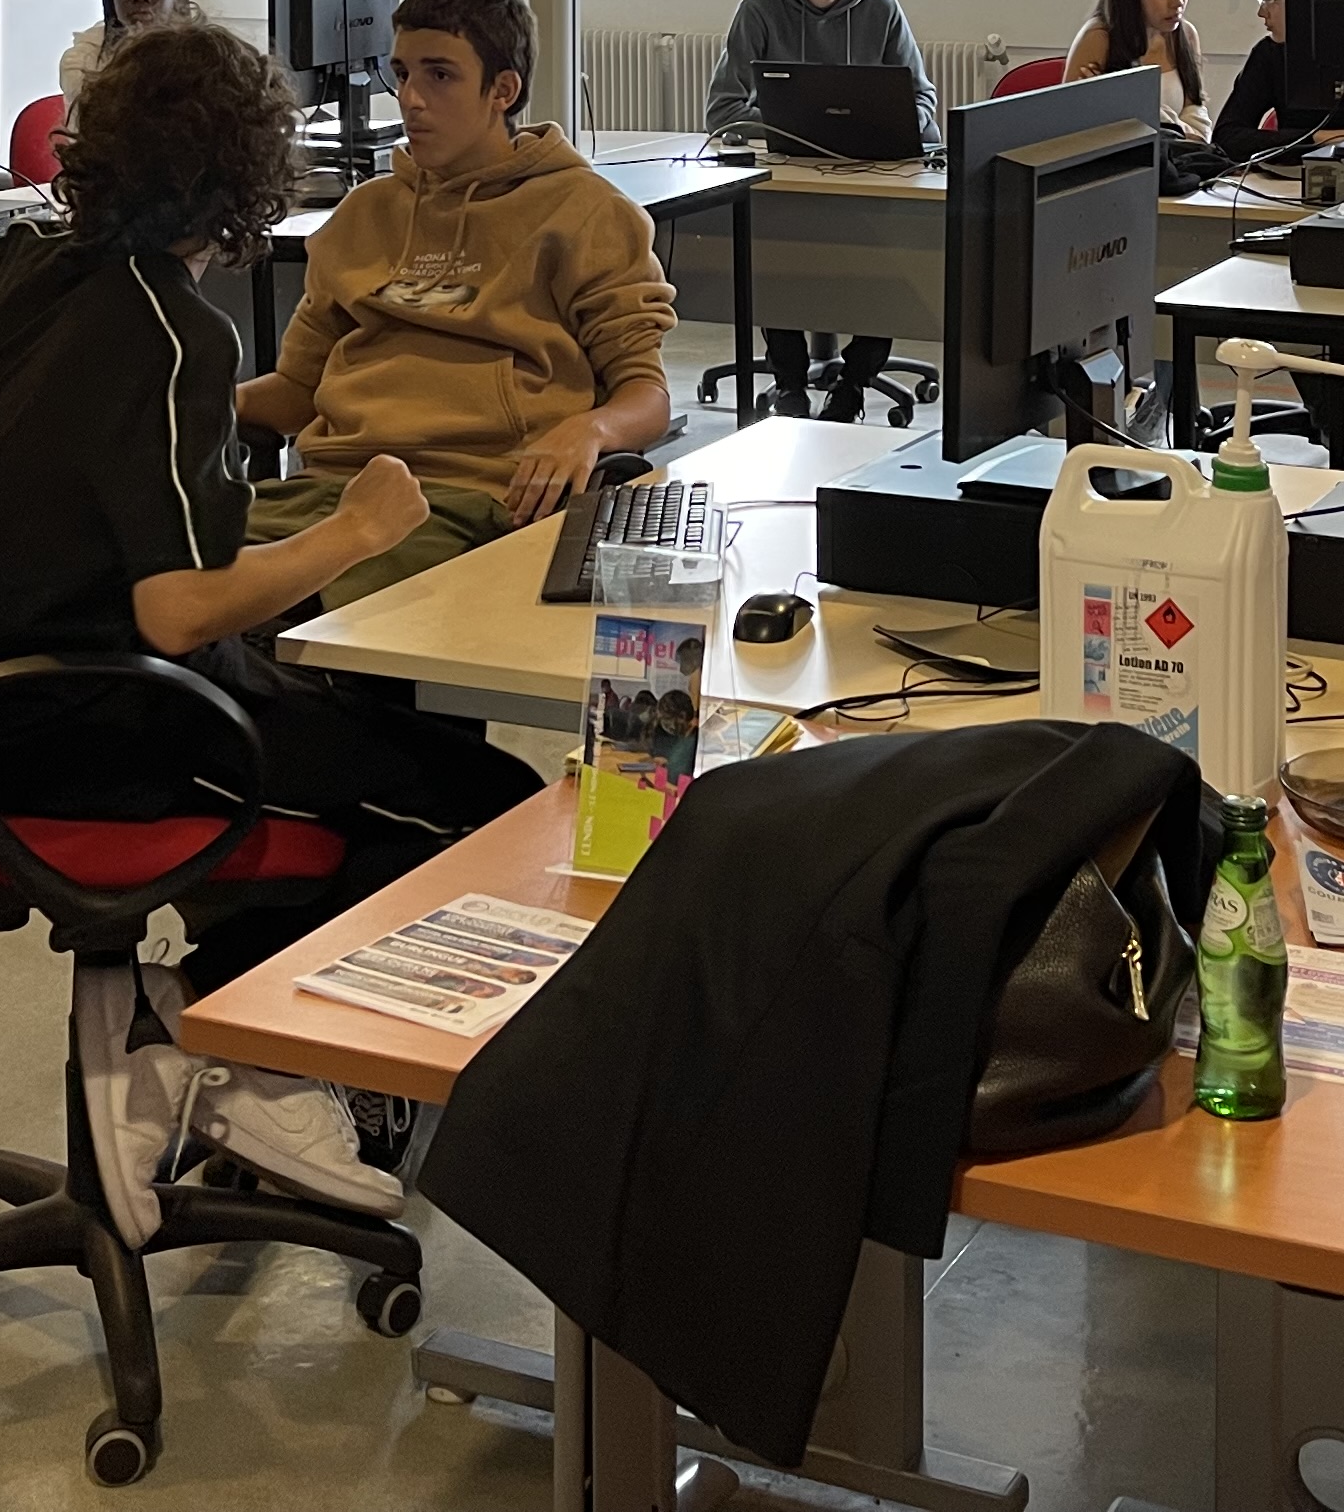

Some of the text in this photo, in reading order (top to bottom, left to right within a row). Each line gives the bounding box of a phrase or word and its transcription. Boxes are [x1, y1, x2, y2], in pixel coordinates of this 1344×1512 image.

[414, 252, 446, 262] MONA
[1119, 654, 1184, 674] Lotion AD 70
